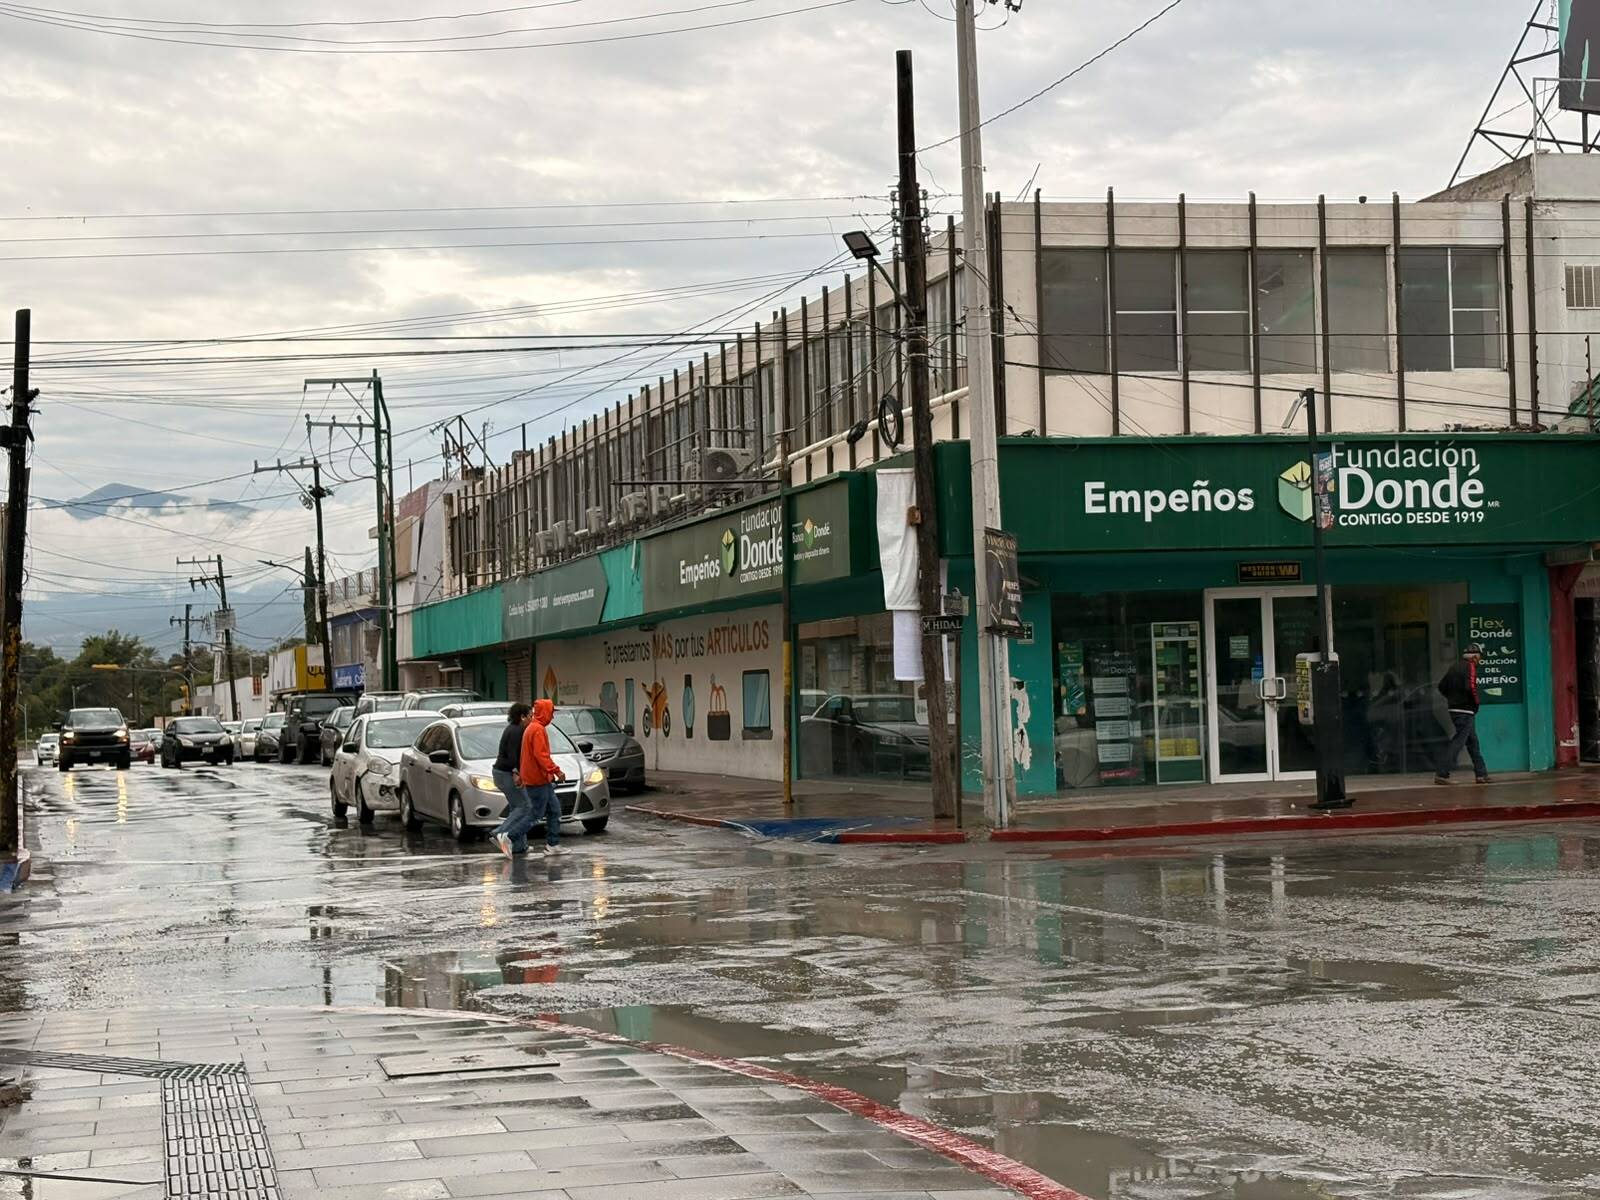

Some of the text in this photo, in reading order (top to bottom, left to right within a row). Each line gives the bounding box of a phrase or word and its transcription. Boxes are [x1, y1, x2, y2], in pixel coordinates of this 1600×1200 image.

[1331, 440, 1477, 468] Fundación
[1084, 479, 1255, 522] Empeños
[1338, 464, 1484, 510] Dondé
[1338, 511, 1484, 526] CONTIGO DESDE 1919
[741, 523, 783, 571] Dondé
[680, 554, 720, 589] Empeños
[740, 570, 758, 583] CONTIGO
[758, 566, 772, 579] DESDE
[1470, 617, 1504, 629] Flex
[1470, 629, 1512, 638] Dondé
[604, 641, 612, 664] Te
[612, 639, 650, 669] prestamos
[675, 637, 690, 664] por
[690, 632, 705, 656] tus
[707, 618, 769, 655] ARTÍCULOS
[1476, 675, 1518, 684] MPEÑO
